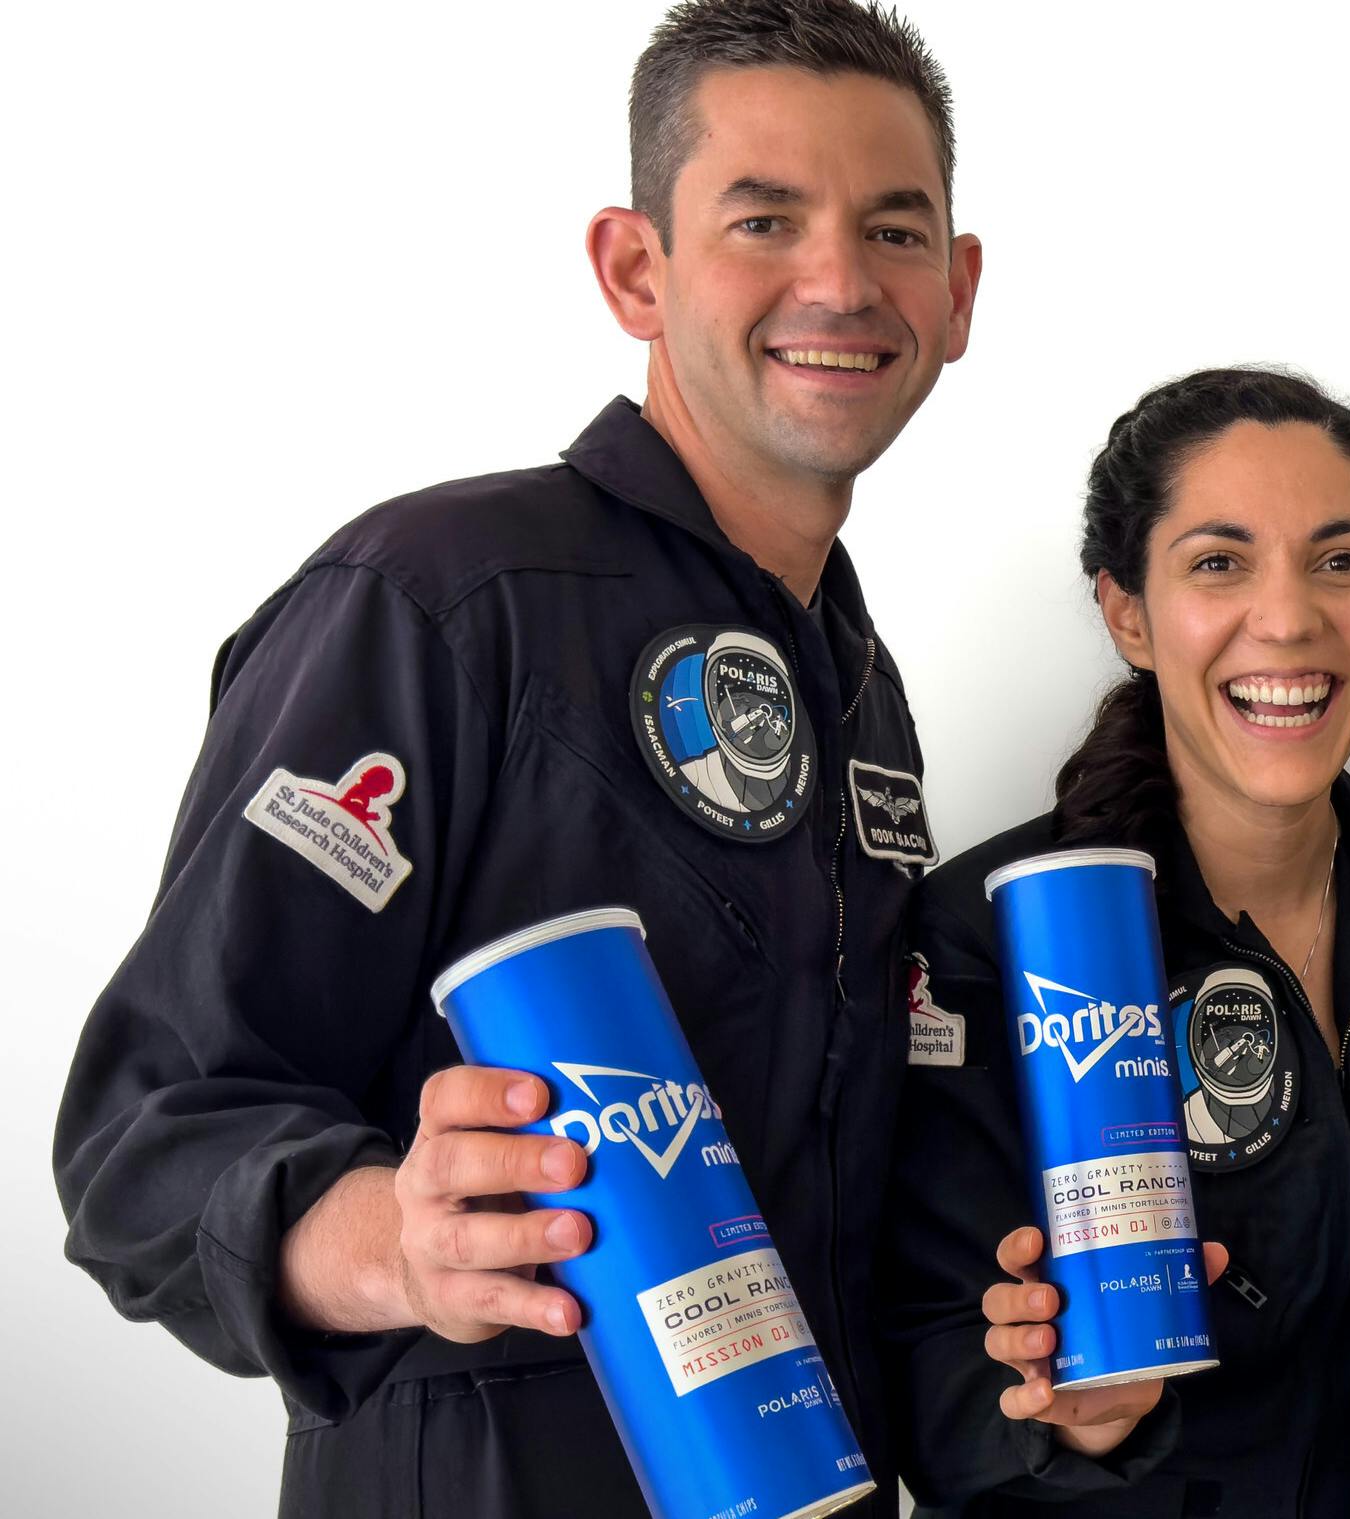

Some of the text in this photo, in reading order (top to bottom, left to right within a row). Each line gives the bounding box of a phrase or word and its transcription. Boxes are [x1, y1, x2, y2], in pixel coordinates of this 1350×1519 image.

[719, 664, 778, 688] POLARIS
[644, 714, 677, 778] ISAACMAN
[794, 754, 810, 797] MENON
[697, 800, 734, 828] POTEET
[759, 812, 786, 830] GILLIS
[264, 798, 385, 893] Research Hospital
[294, 798, 331, 829] Jude
[331, 821, 394, 880] Children's
[1206, 1004, 1262, 1016] POLARIS
[911, 1023, 954, 1037] hildren's
[1017, 1000, 1163, 1057] Doritos
[910, 1040, 953, 1055] Hospital
[1280, 1071, 1292, 1111] MENON
[1109, 1129, 1145, 1140] LIMITED
[1245, 1131, 1272, 1155] GILLIS
[1189, 1149, 1218, 1162] TEET
[1051, 1164, 1144, 1188] ZERO GRAVITY
[1053, 1184, 1111, 1205] COOL
[1055, 1209, 1091, 1222] FLAVORED
[1100, 1203, 1128, 1213] MINIS
[1130, 1199, 1169, 1209] TORTILLA
[1058, 1219, 1149, 1246] MISSION 01
[656, 1261, 765, 1312] ZERO GRAVITY
[1100, 1273, 1162, 1294] POLARIS
[1140, 1284, 1163, 1294] DAWN
[664, 1275, 791, 1330] COOL RANC
[673, 1322, 724, 1351] FLAVORED
[734, 1308, 764, 1325] MINIS
[682, 1325, 791, 1378] MISSION 01
[757, 1384, 822, 1419] POLARIS
